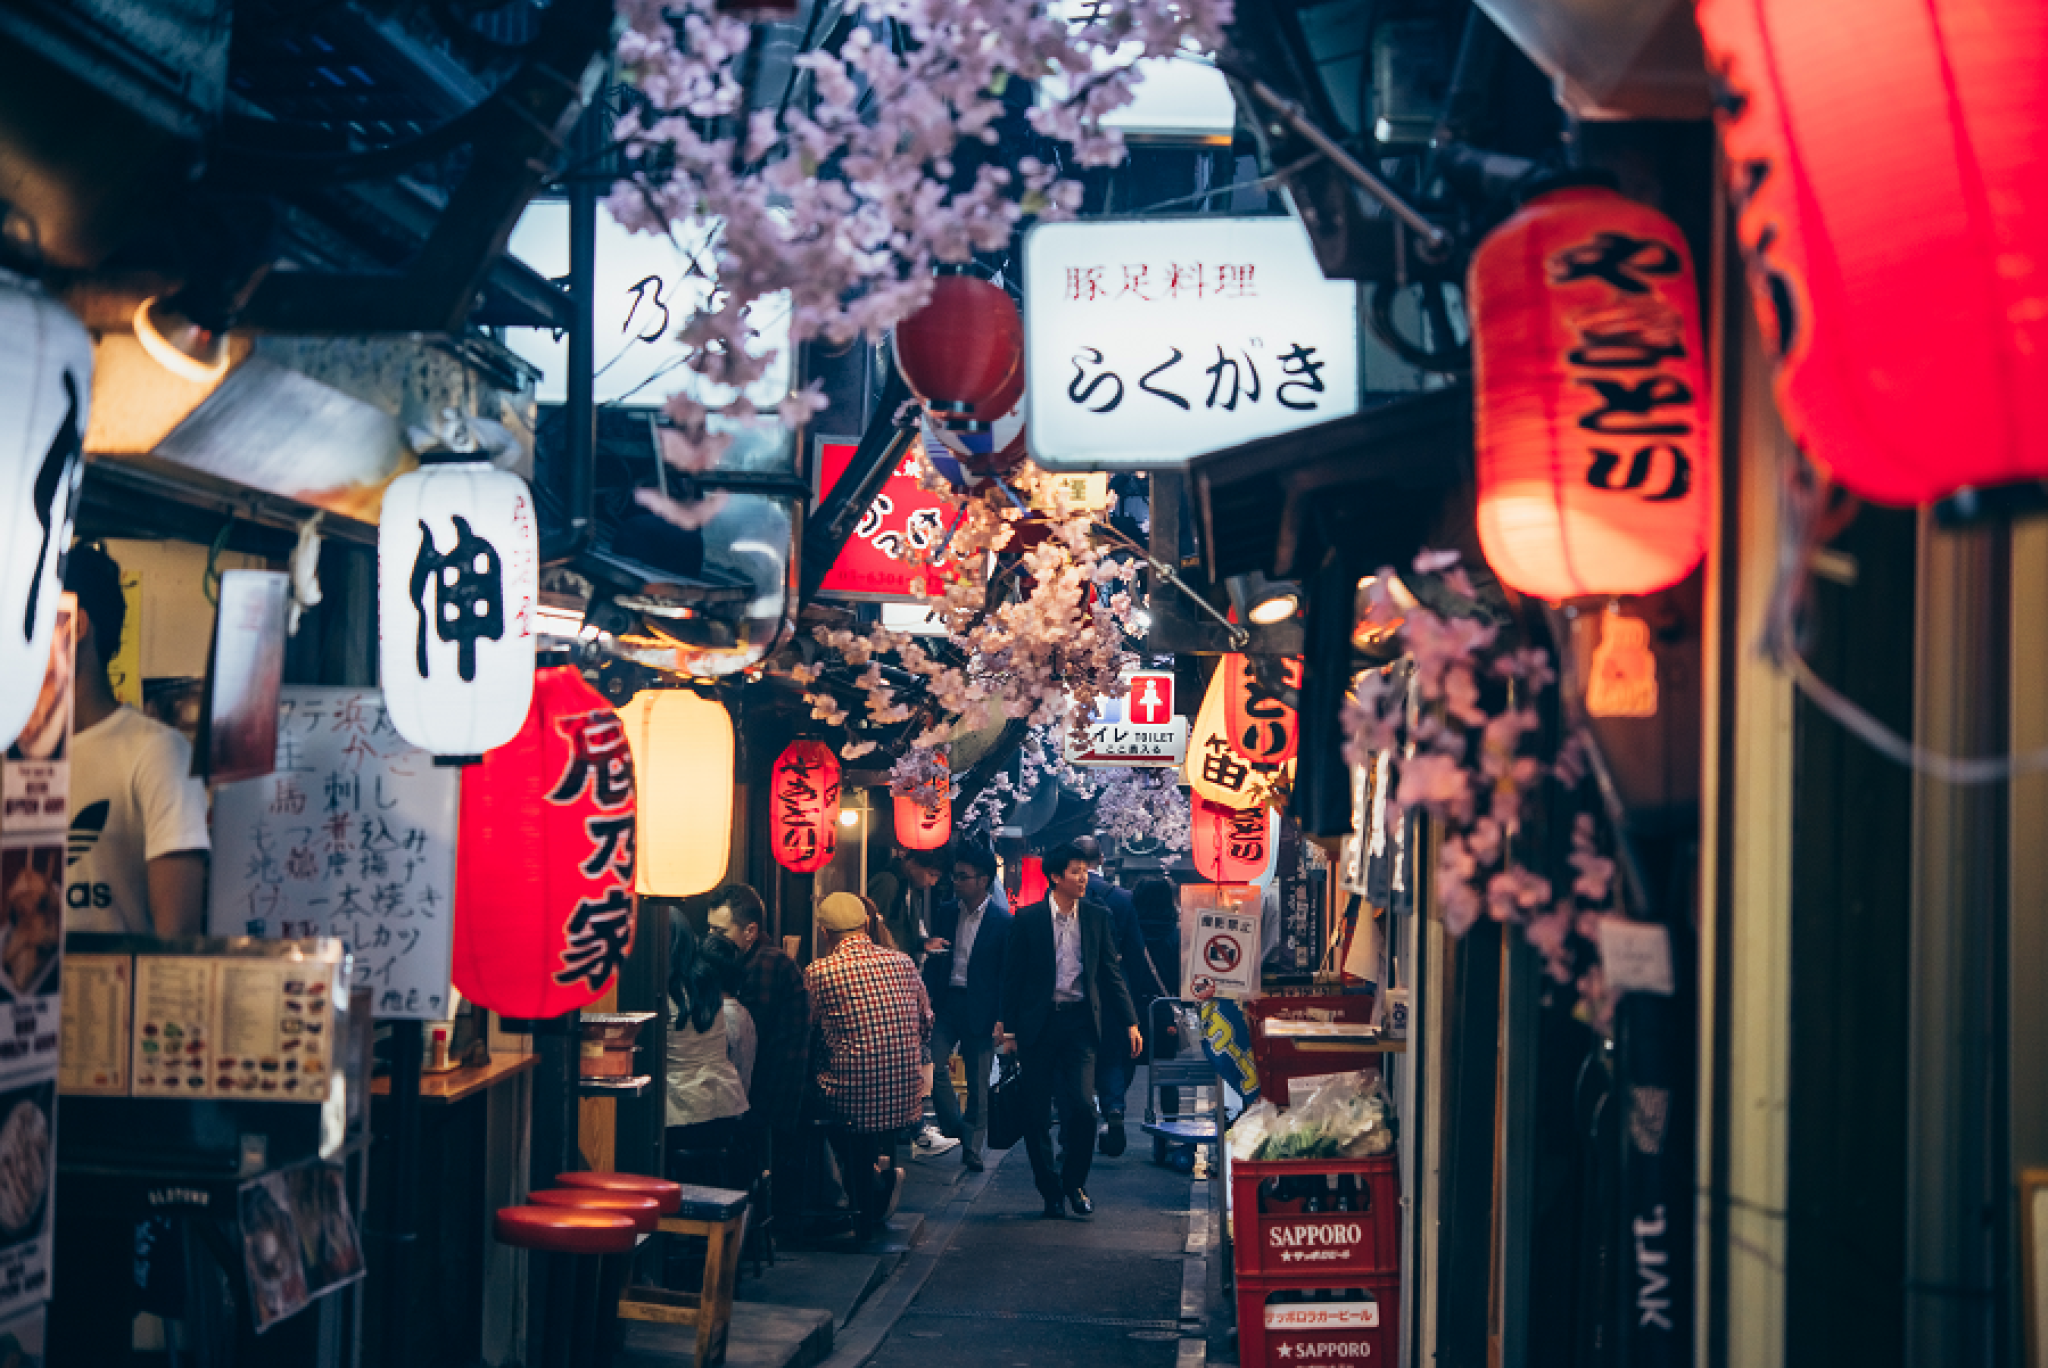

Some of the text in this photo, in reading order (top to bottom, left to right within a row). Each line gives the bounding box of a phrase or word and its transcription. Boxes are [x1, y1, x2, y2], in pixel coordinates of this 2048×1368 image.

[1063, 260, 1258, 302] 豚足料理
[1067, 337, 1326, 414] らくがき
[409, 514, 505, 683] 伸
[1134, 731, 1174, 743] TOILET
[1269, 1222, 1362, 1247] SAPPORO
[1295, 1341, 1371, 1358] SAPPORO
